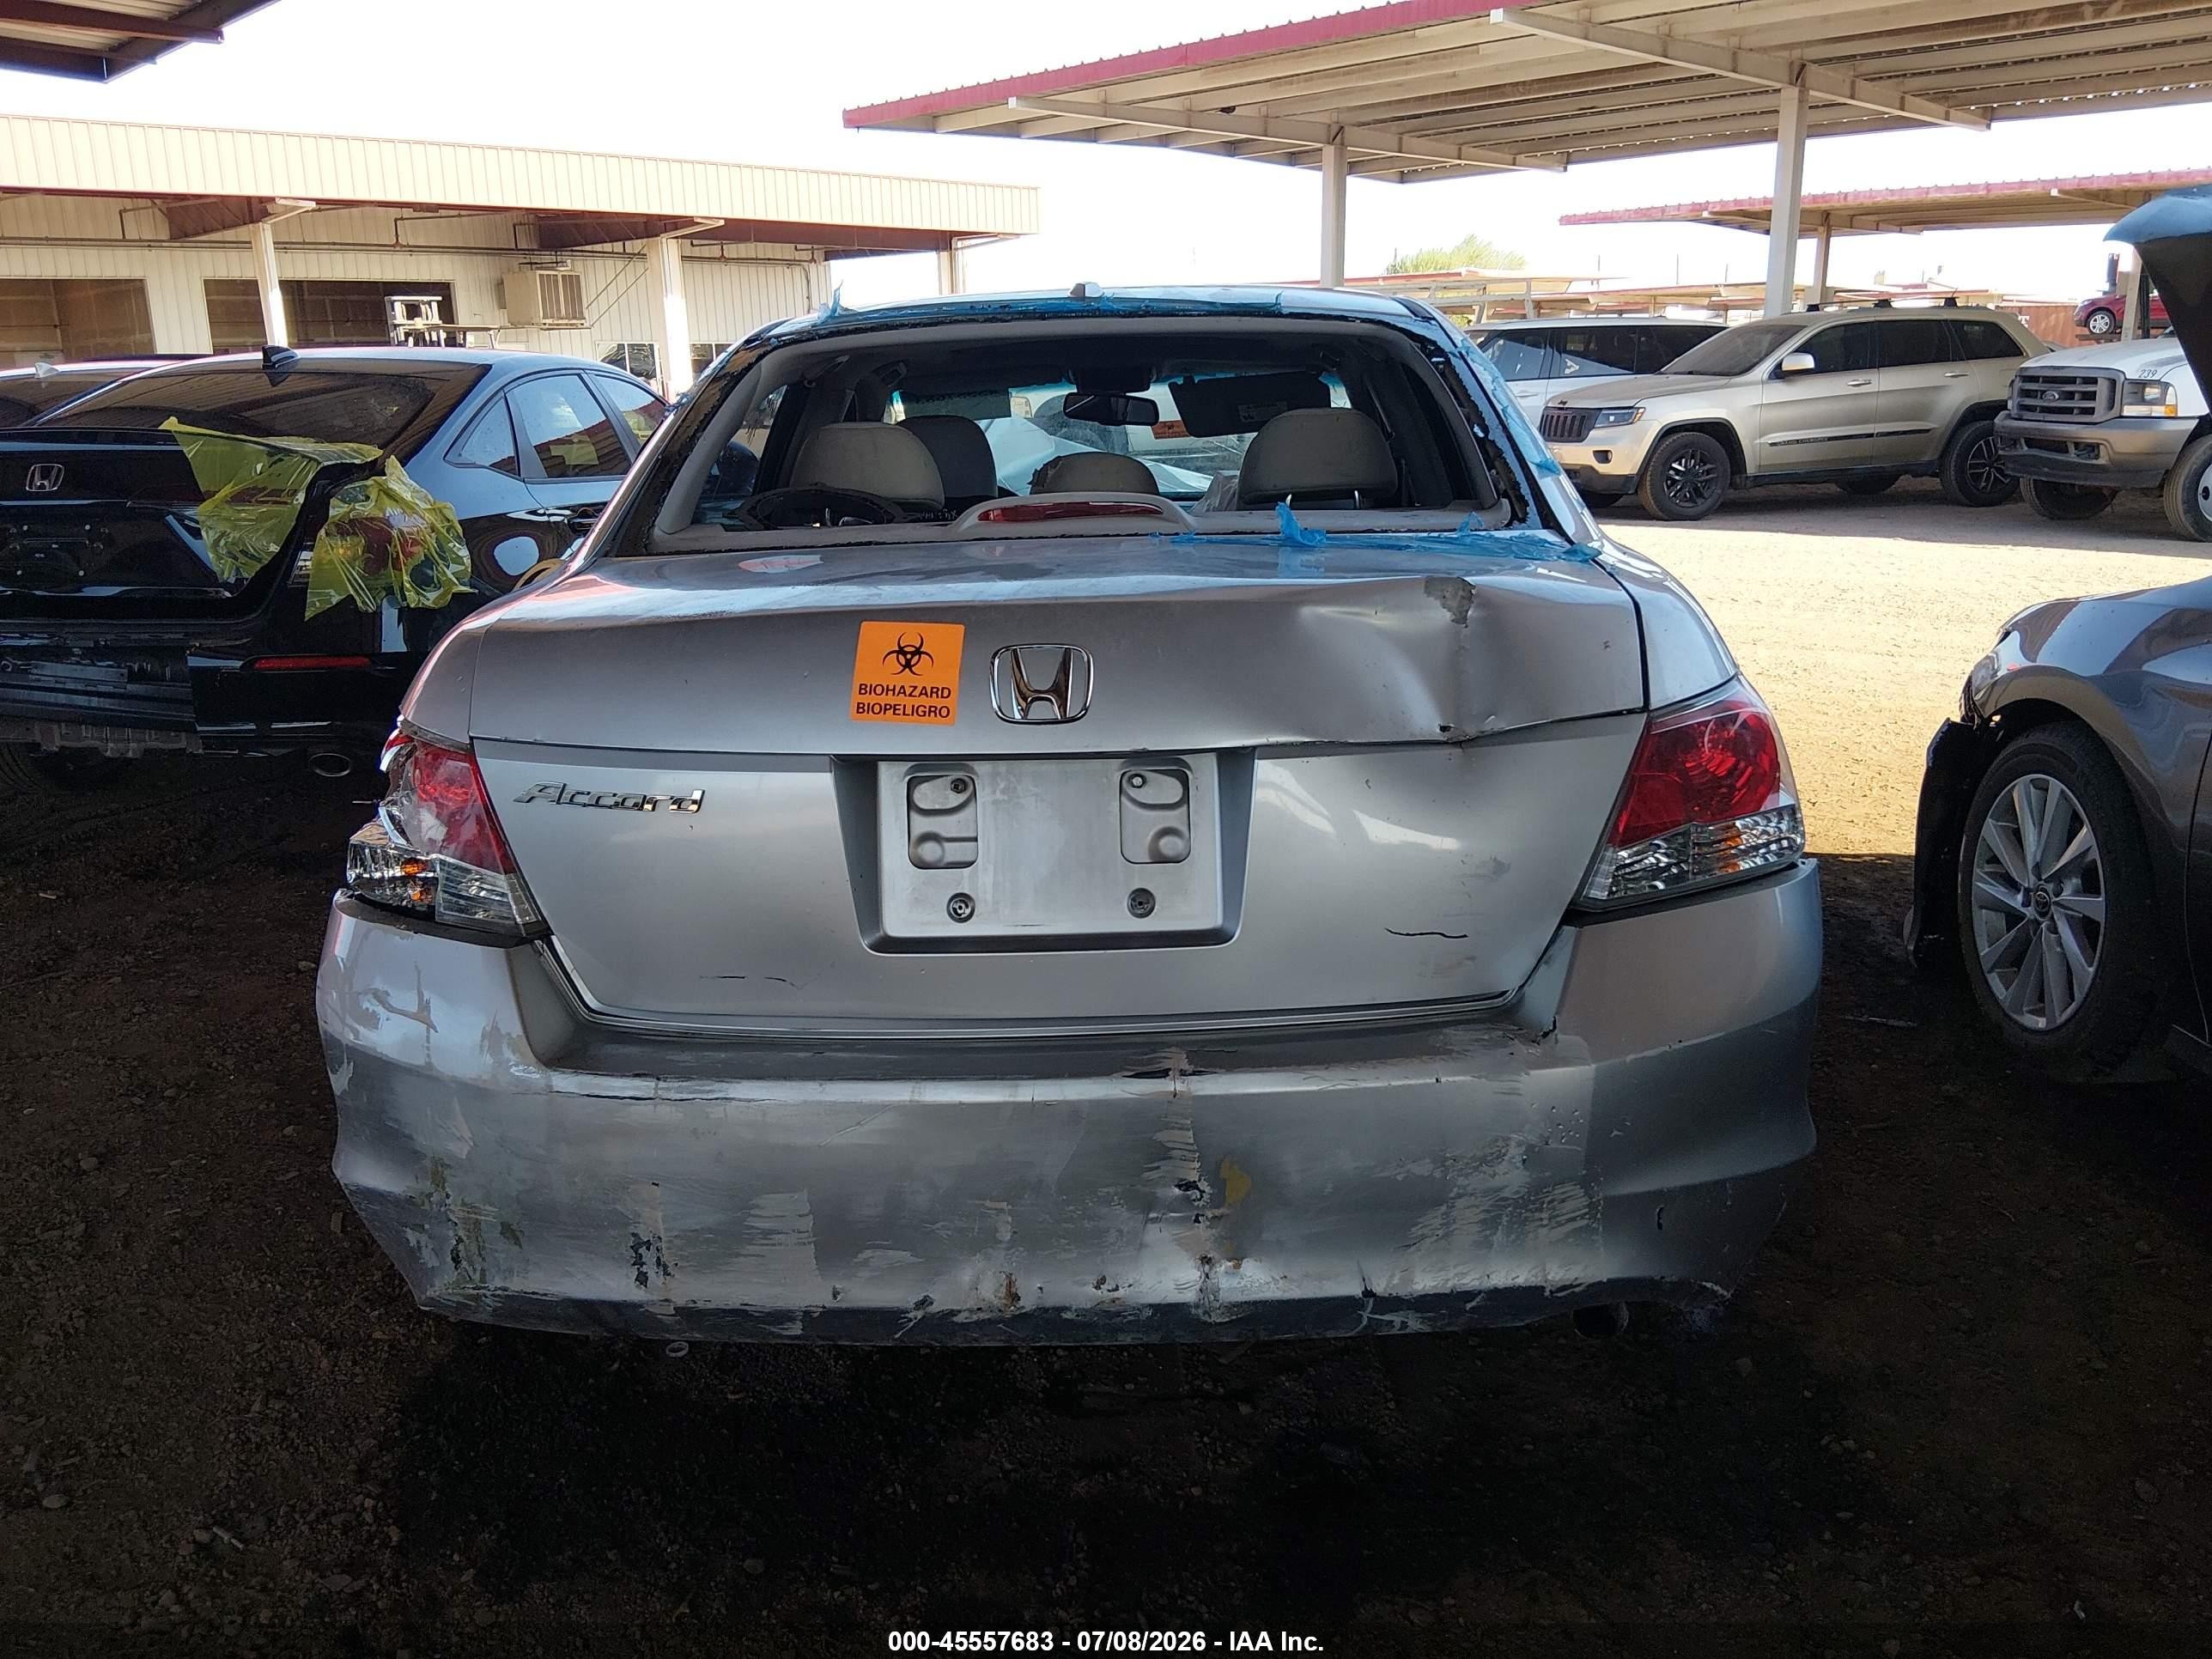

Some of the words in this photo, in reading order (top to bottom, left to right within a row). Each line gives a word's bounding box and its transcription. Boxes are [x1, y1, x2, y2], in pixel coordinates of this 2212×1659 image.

[2138, 368, 2158, 379] 239
[858, 683, 951, 700] BIOHAZARD
[855, 702, 951, 720] BIOPELIGRO
[514, 780, 706, 814] Accord
